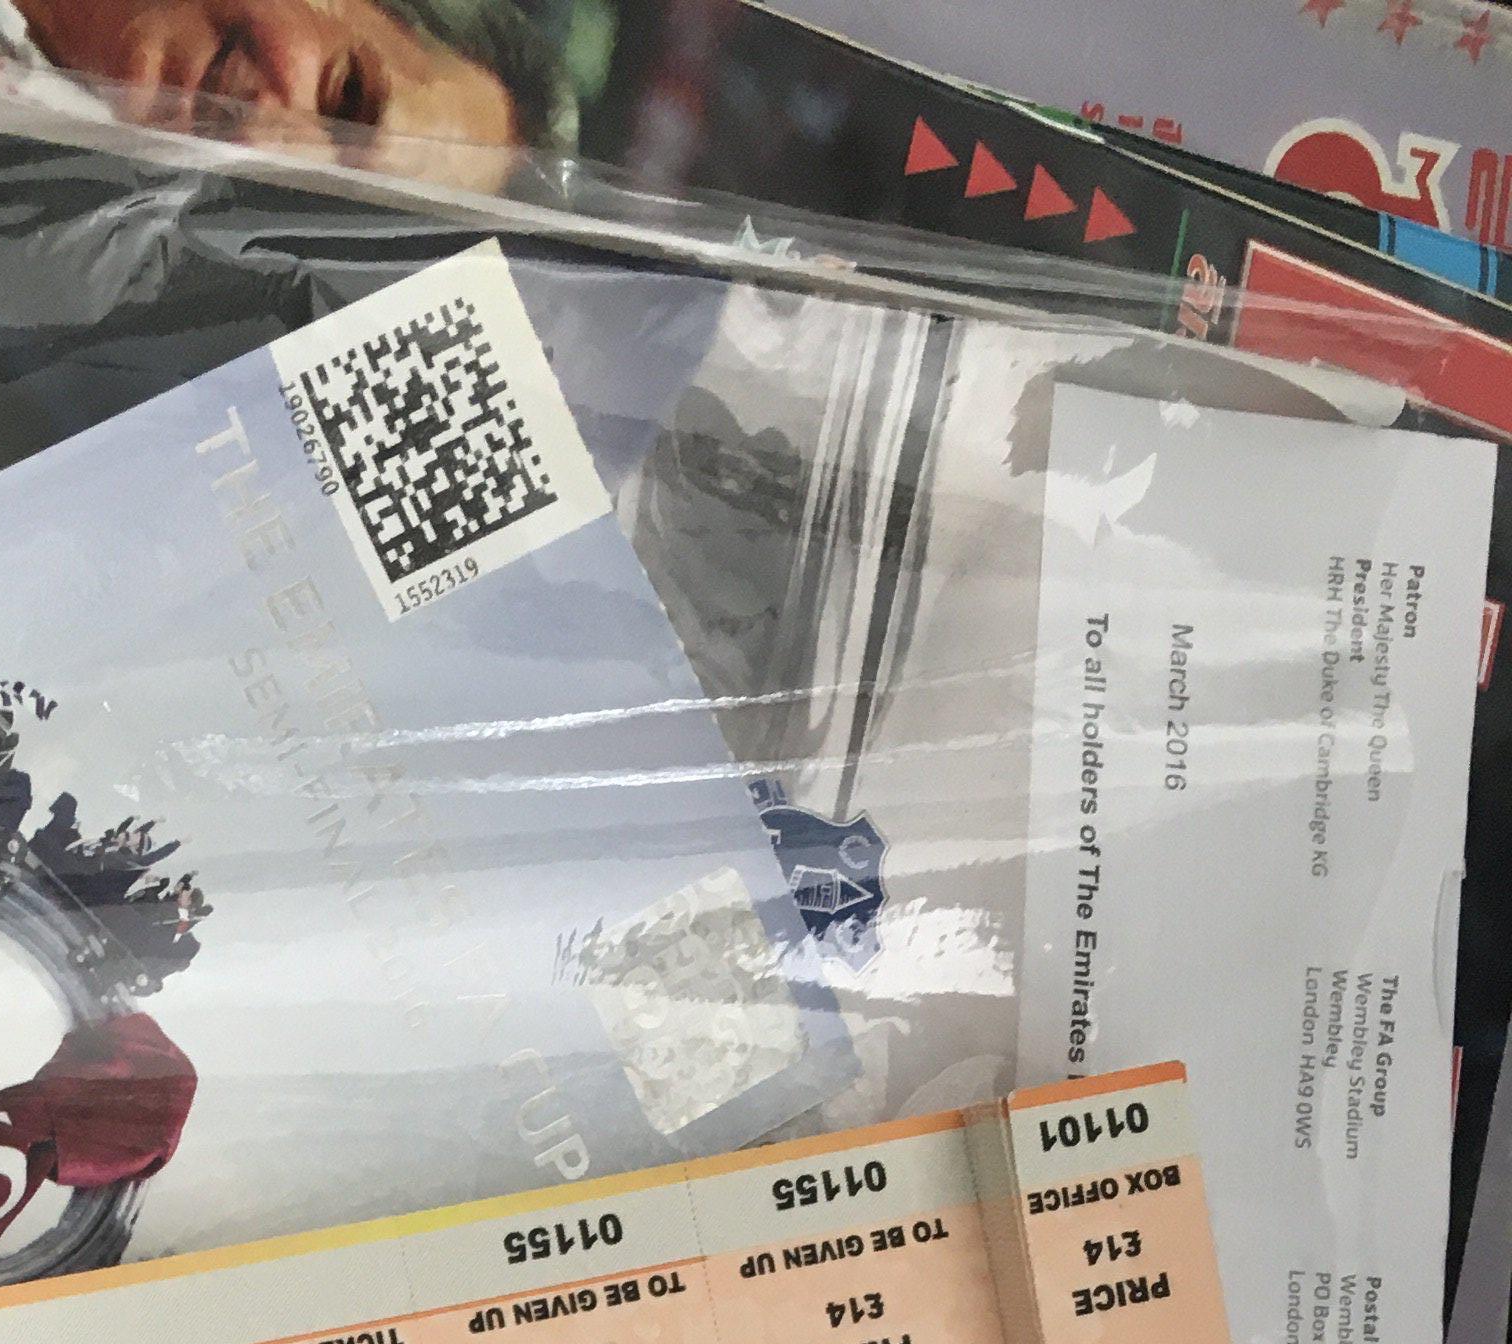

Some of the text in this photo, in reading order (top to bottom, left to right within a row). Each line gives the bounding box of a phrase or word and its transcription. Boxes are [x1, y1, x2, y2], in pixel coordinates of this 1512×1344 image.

[280, 380, 341, 496] 19026790
[395, 557, 480, 613] 1552319
[1403, 564, 1427, 640] Patron
[1164, 623, 1195, 791] March 2016
[1066, 612, 1110, 1064] To all holders of The Emirates
[1370, 975, 1399, 1118] The FA Group
[1037, 1101, 1150, 1153] 01101
[771, 1160, 887, 1210] 01155
[1028, 1164, 1181, 1214] BOX OFFICE
[503, 1212, 623, 1265] 01155
